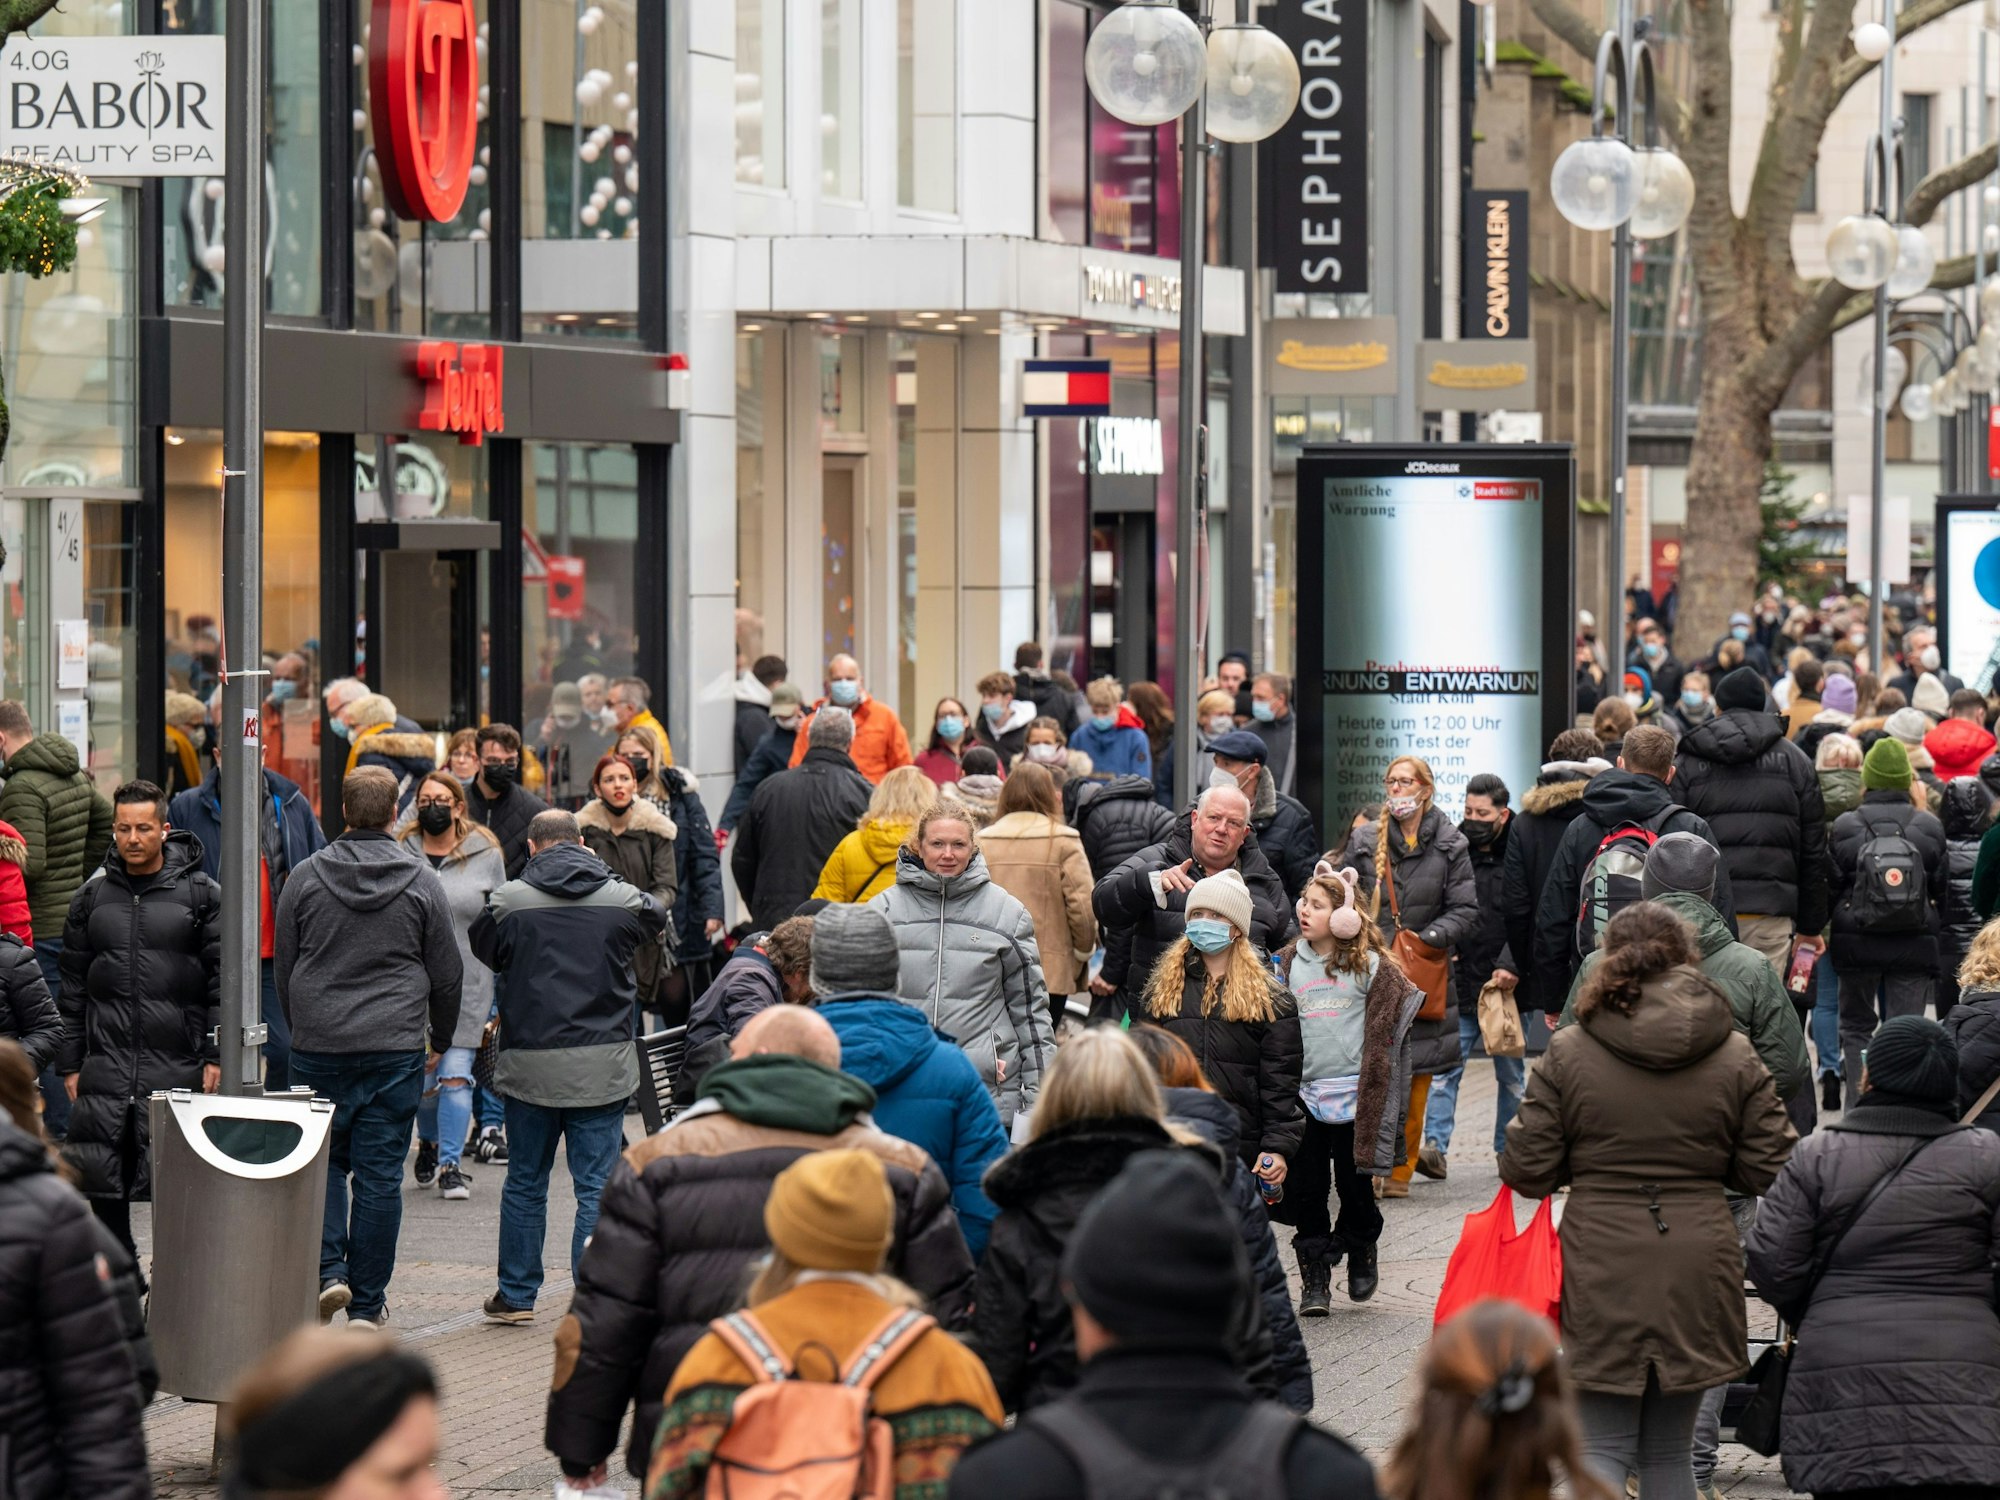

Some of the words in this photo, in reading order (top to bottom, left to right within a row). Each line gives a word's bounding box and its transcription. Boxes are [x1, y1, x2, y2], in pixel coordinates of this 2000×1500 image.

[10, 50, 69, 70] 4.OG
[11, 81, 214, 130] BABOR
[1300, 0, 1342, 282] SEPHORA
[152, 145, 213, 162] SPA
[1486, 199, 1510, 258] KLEIN
[1486, 259, 1510, 337] CALVIN
[1405, 461, 1460, 473] JCDecaux
[1329, 484, 1392, 497] Amtliche
[1475, 487, 1498, 497] Stadt
[1499, 487, 1519, 497] Köln
[1329, 502, 1396, 518] Warnung
[57, 510, 68, 534] 41
[68, 539, 79, 562] 45
[1405, 672, 1539, 691] ENTWARNUN
[1338, 715, 1385, 730] Heute
[1391, 718, 1416, 730] um
[1472, 715, 1502, 730] Uhr
[1337, 734, 1371, 748] wird
[1375, 734, 1399, 748] ein
[1405, 735, 1440, 748] Test
[1445, 734, 1471, 748] der
[1446, 753, 1465, 766] im
